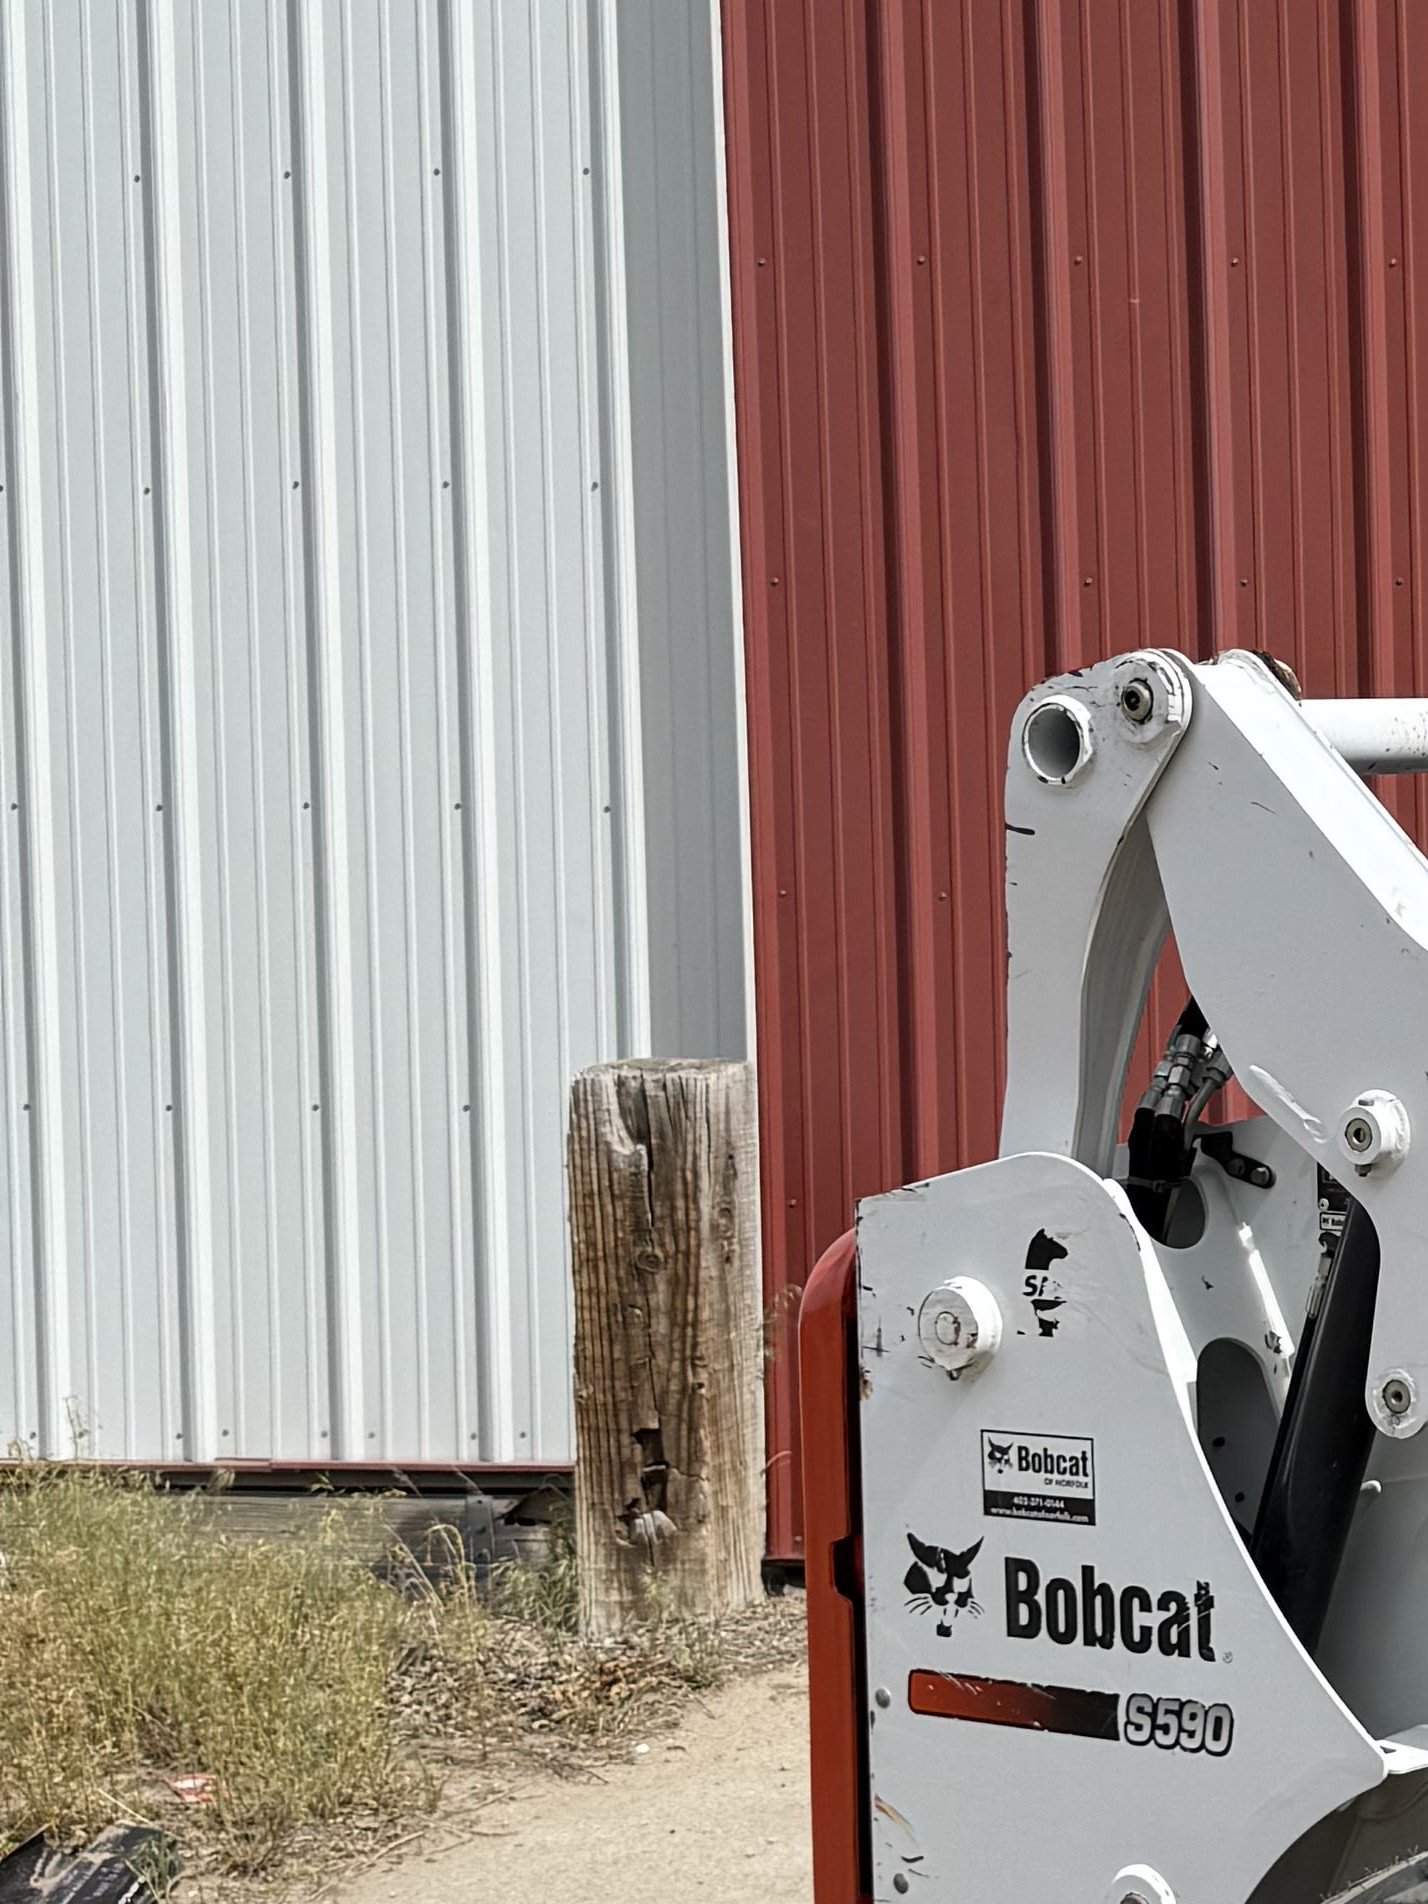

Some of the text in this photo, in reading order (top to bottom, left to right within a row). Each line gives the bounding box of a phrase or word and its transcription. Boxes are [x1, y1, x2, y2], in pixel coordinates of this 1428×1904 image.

[1017, 1445, 1090, 1478] Bobcat
[1004, 1556, 1216, 1662] Bobcat
[1124, 1693, 1234, 1757] S590
